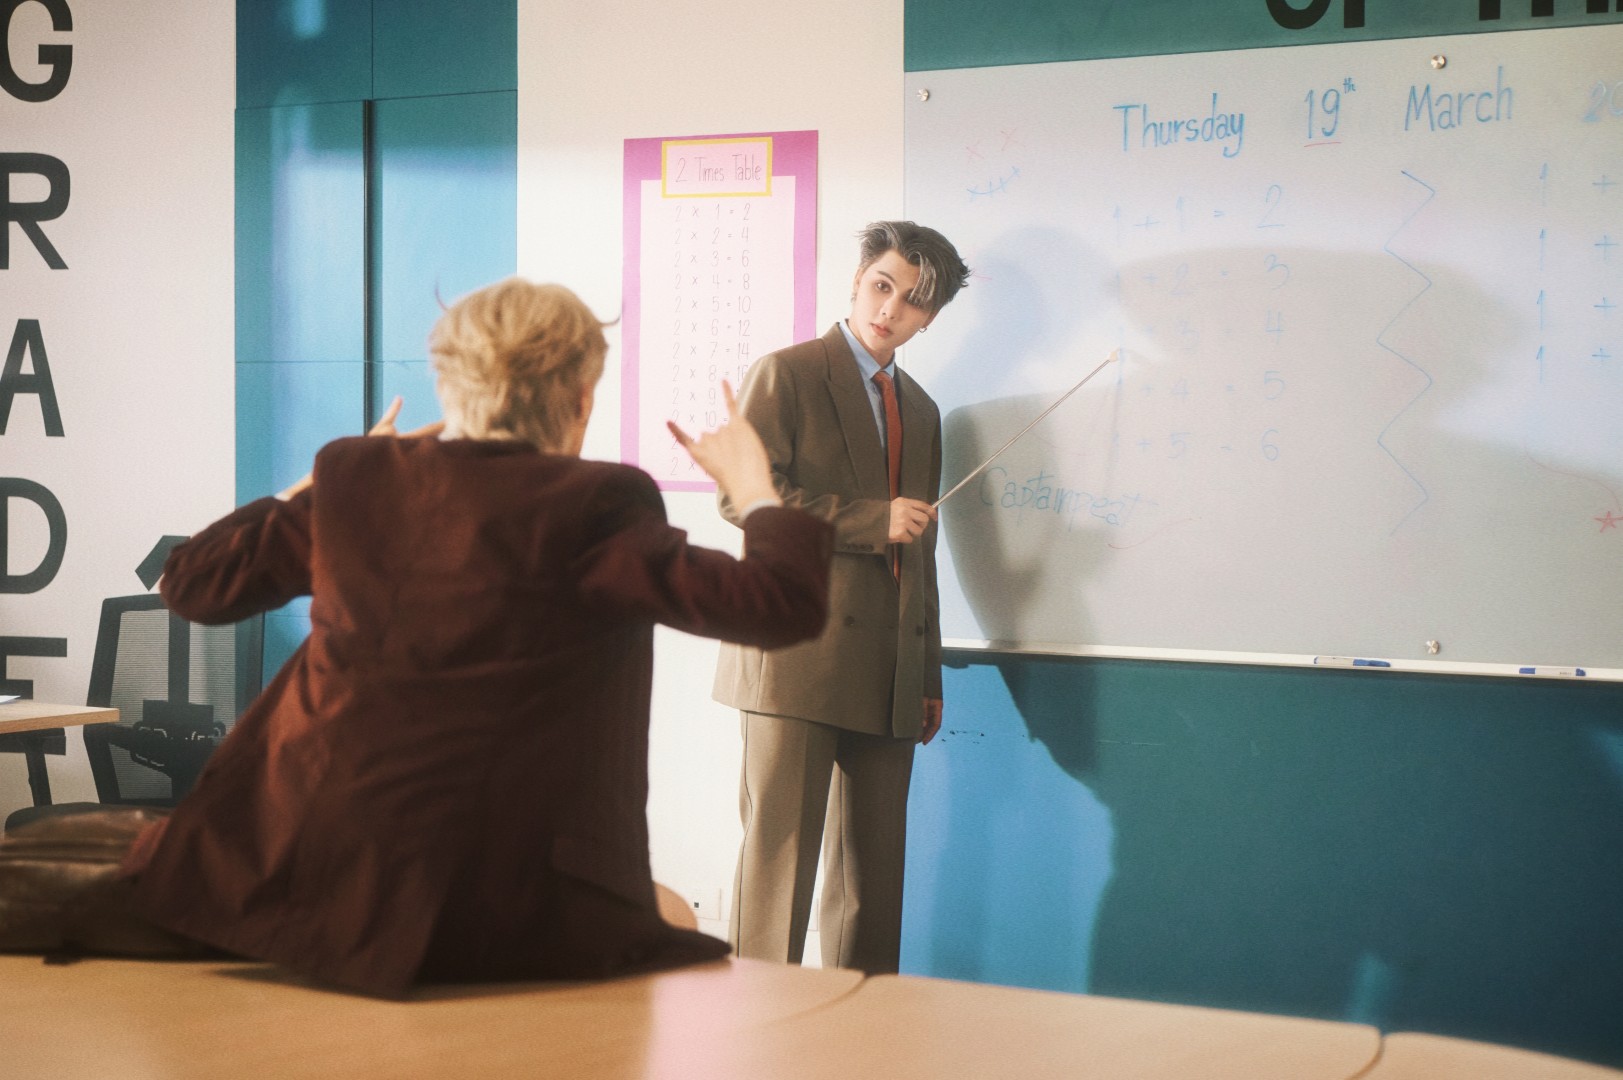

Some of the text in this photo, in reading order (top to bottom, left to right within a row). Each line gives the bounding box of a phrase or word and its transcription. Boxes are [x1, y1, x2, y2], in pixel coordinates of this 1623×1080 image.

[1112, 92, 1246, 159] Thursday
[1404, 65, 1514, 132] March
[674, 154, 762, 183] 2 Times Table
[674, 204, 682, 222] 2
[715, 203, 721, 220] 1
[743, 202, 751, 221] 2
[1257, 184, 1285, 228] 2
[674, 228, 682, 245] 2
[711, 226, 720, 245] 2
[741, 226, 749, 243] 4
[673, 251, 681, 268] 2
[711, 250, 720, 267] 3
[741, 249, 750, 268] 6
[1263, 253, 1291, 290] 3
[674, 273, 682, 290] 2
[712, 273, 720, 289] 4
[742, 273, 750, 290] 8
[674, 296, 682, 313] 2
[712, 296, 720, 313] 5
[738, 295, 752, 313] 10
[673, 319, 681, 336] 2
[711, 318, 719, 336] 6
[738, 319, 751, 337] 12
[1264, 309, 1285, 346] 4
[672, 342, 681, 359] 2
[710, 342, 718, 358] 7
[737, 342, 750, 359] 14
[672, 365, 679, 382] 2
[708, 364, 716, 382] 8
[1263, 370, 1286, 401] 5
[672, 387, 679, 404] 2
[708, 387, 716, 405] 9
[705, 410, 716, 428] 10
[1260, 428, 1280, 462] 6
[670, 457, 679, 476] 2
